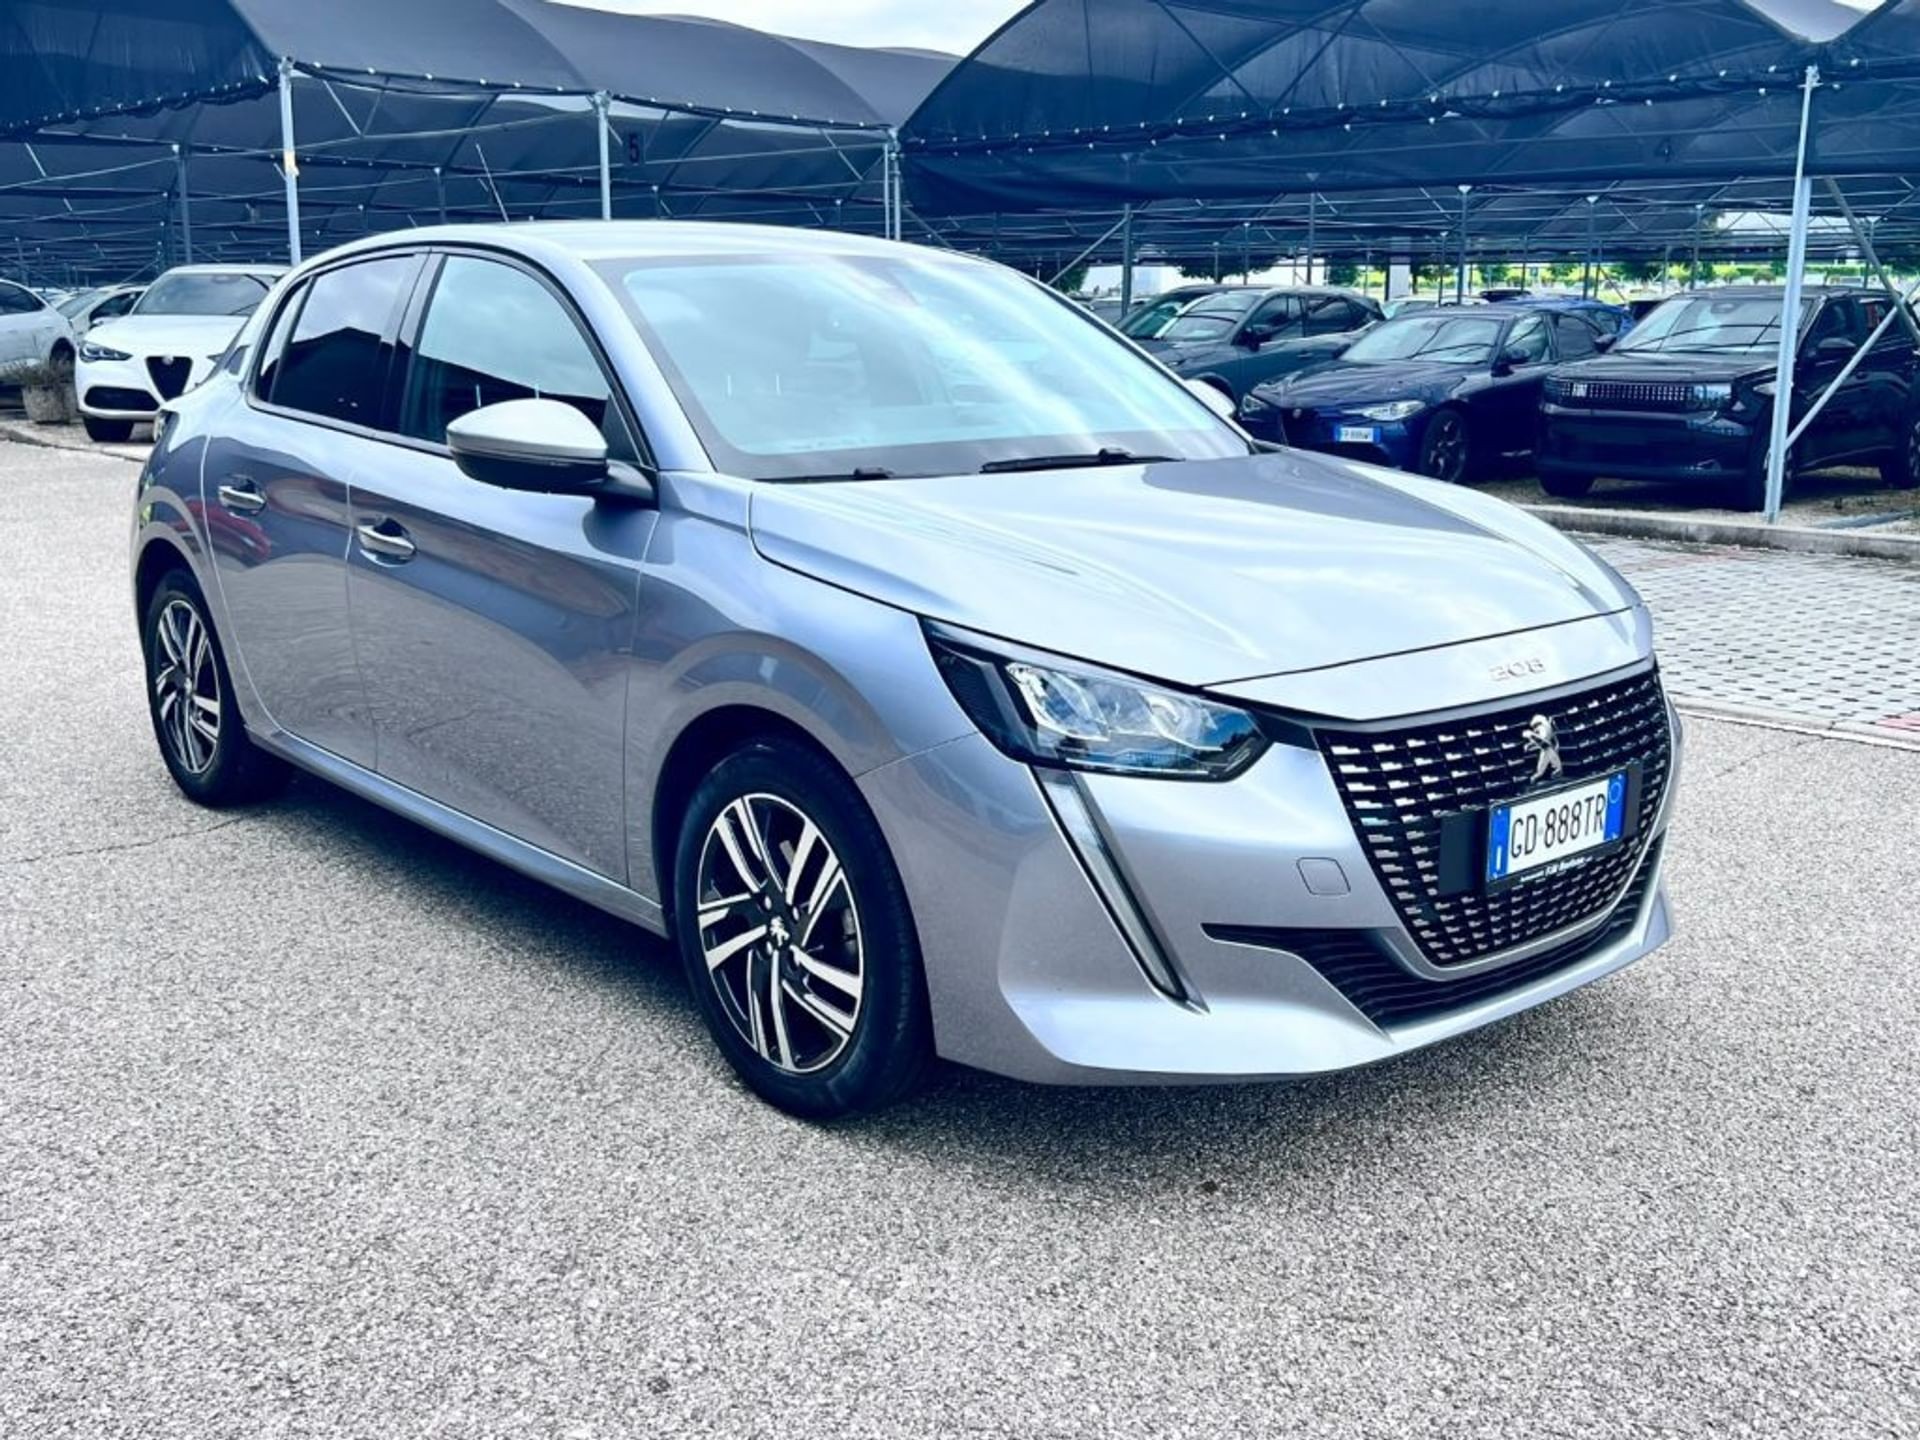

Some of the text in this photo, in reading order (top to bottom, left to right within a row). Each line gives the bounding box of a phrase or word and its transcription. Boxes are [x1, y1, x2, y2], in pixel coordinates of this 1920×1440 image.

[1488, 658, 1546, 681] 208
[1511, 792, 1607, 859] GD 888TR
